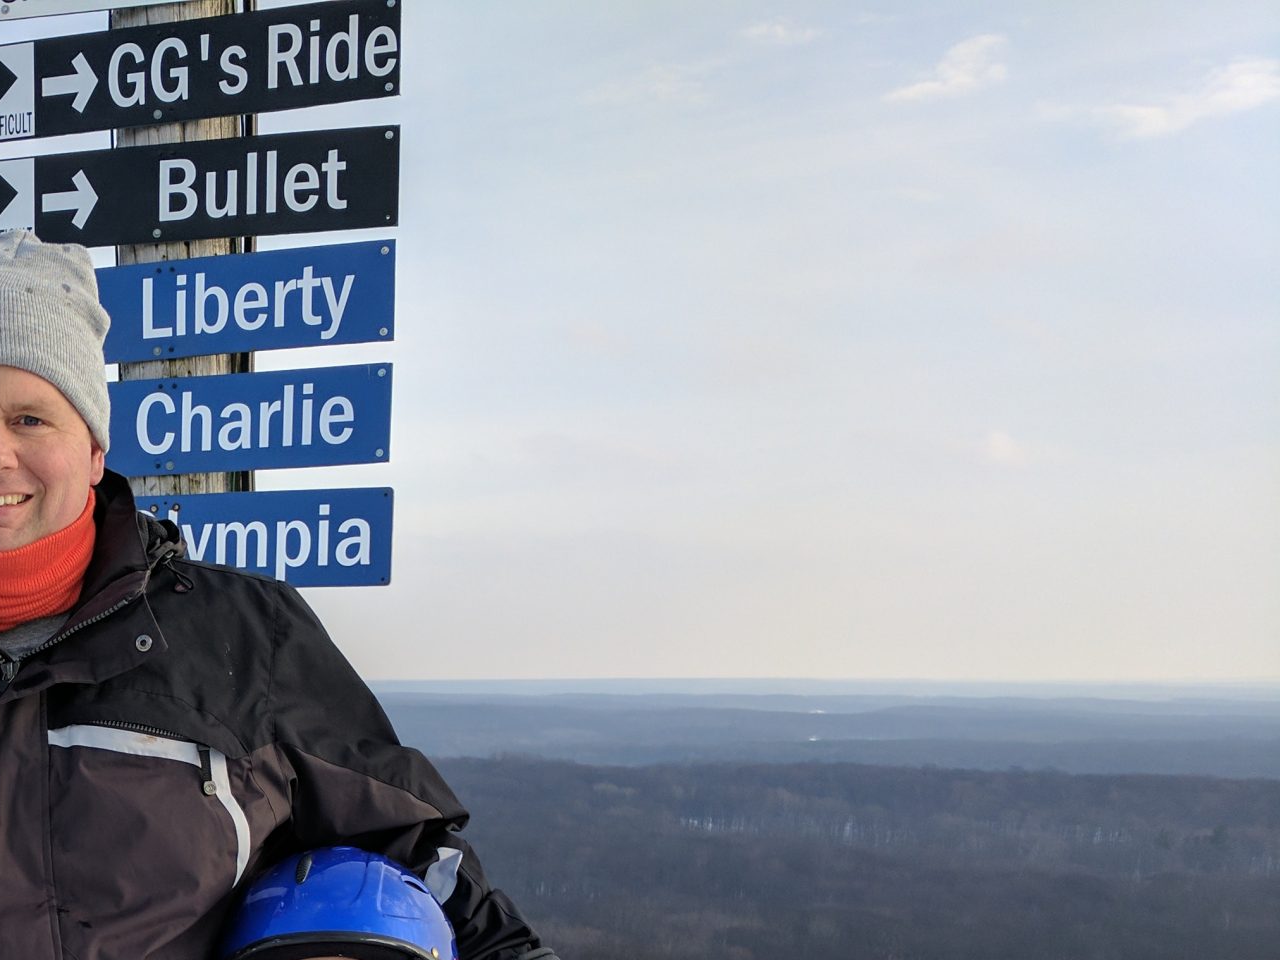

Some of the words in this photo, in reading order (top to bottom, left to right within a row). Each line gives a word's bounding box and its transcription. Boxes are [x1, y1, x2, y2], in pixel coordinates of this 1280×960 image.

[108, 34, 249, 108] GG's
[268, 13, 399, 89] Ride
[158, 149, 348, 223] Bullet
[141, 265, 356, 340] Liberty
[135, 382, 355, 456] Charlie
[167, 504, 372, 581] ympia
